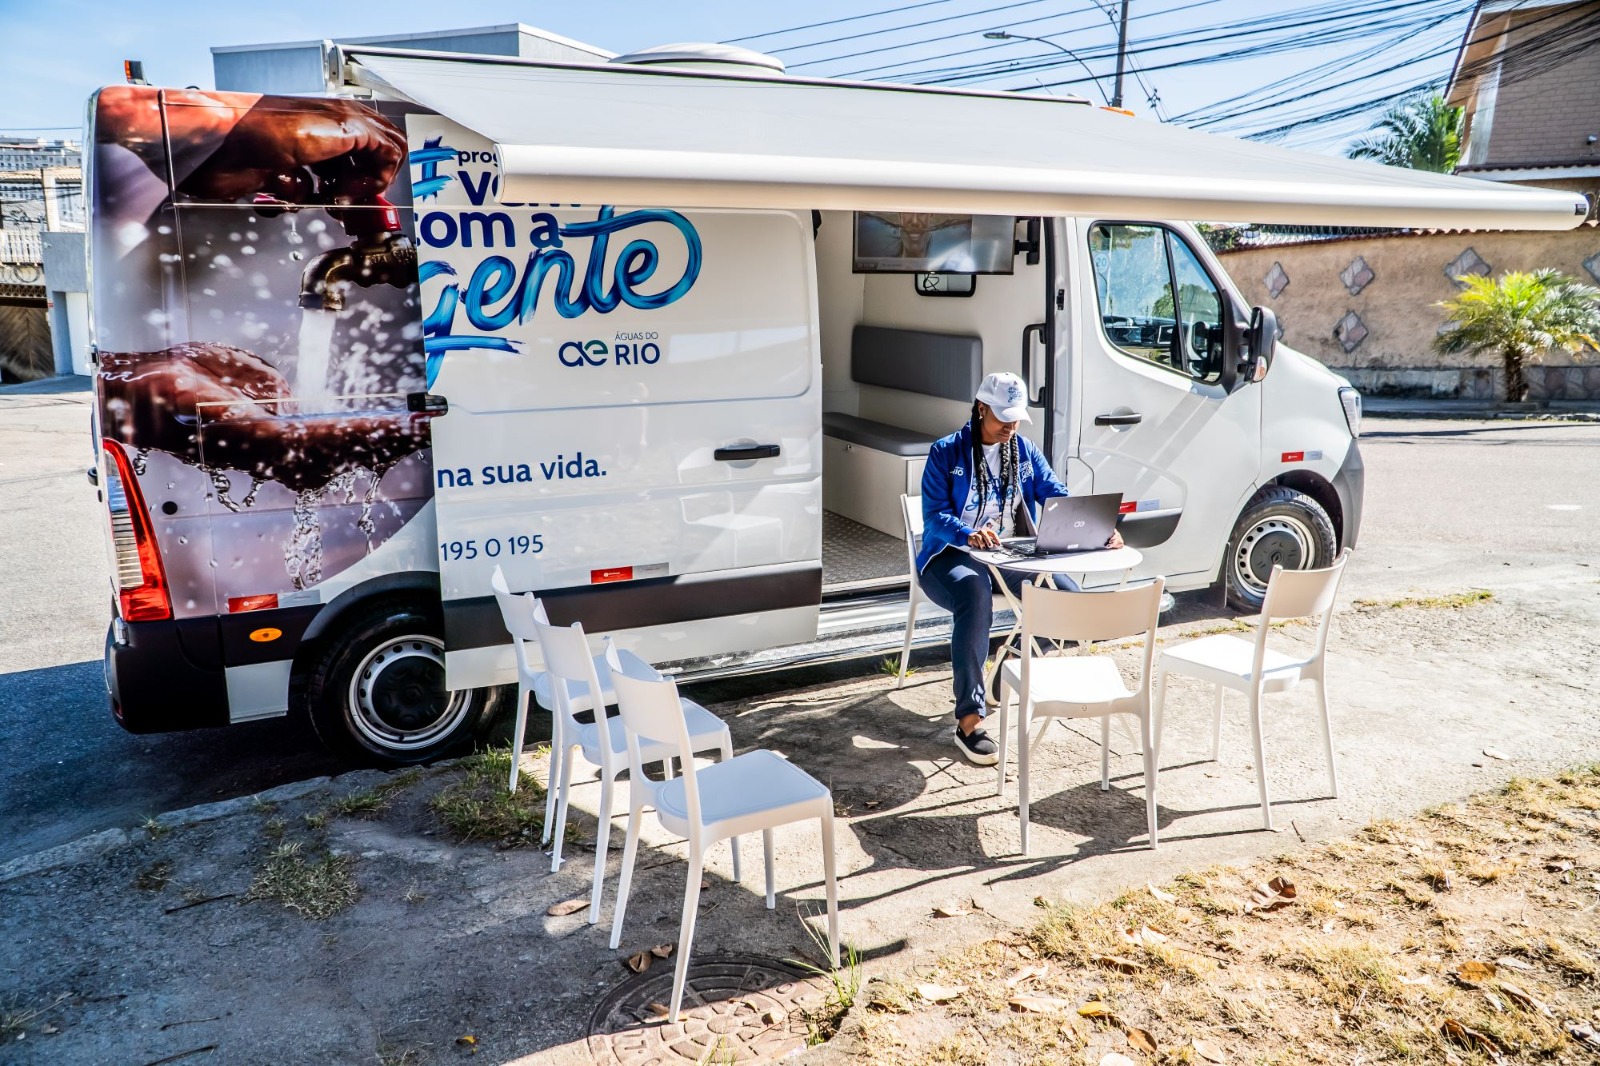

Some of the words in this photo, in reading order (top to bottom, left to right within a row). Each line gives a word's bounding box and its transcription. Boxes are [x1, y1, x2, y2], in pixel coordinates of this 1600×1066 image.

[530, 212, 563, 248] a
[614, 331, 642, 341] ÁGUAS
[645, 331, 659, 340] DO
[614, 342, 661, 366] RIO
[437, 468, 474, 489] na
[481, 464, 532, 485] sua
[540, 452, 607, 480] vida.
[440, 540, 478, 562] 195
[508, 534, 544, 555] 195
